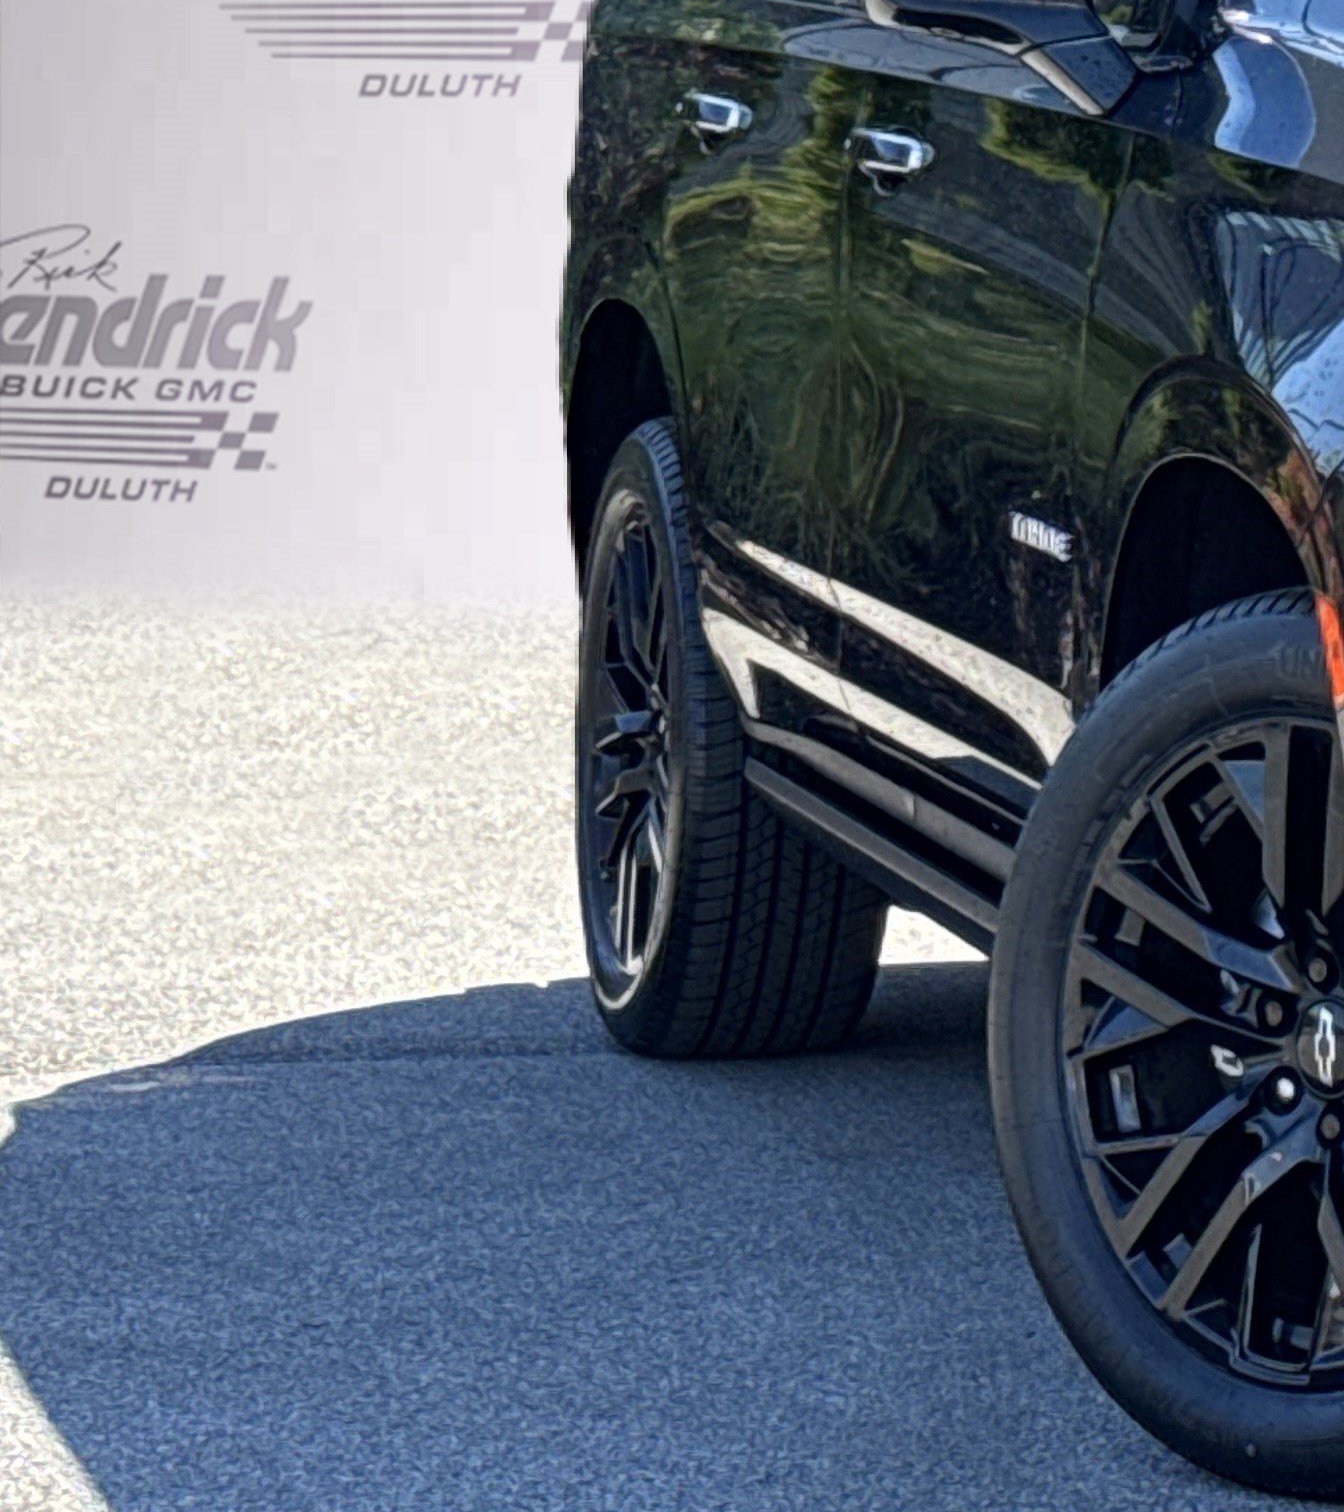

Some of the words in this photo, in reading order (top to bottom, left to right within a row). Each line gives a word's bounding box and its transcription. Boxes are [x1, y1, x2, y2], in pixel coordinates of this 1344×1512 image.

[358, 73, 522, 98] DULUTH
[0, 273, 313, 372] endrick
[0, 374, 140, 401] BUICK
[154, 377, 258, 404] GMC
[44, 475, 198, 504] DULUTH
